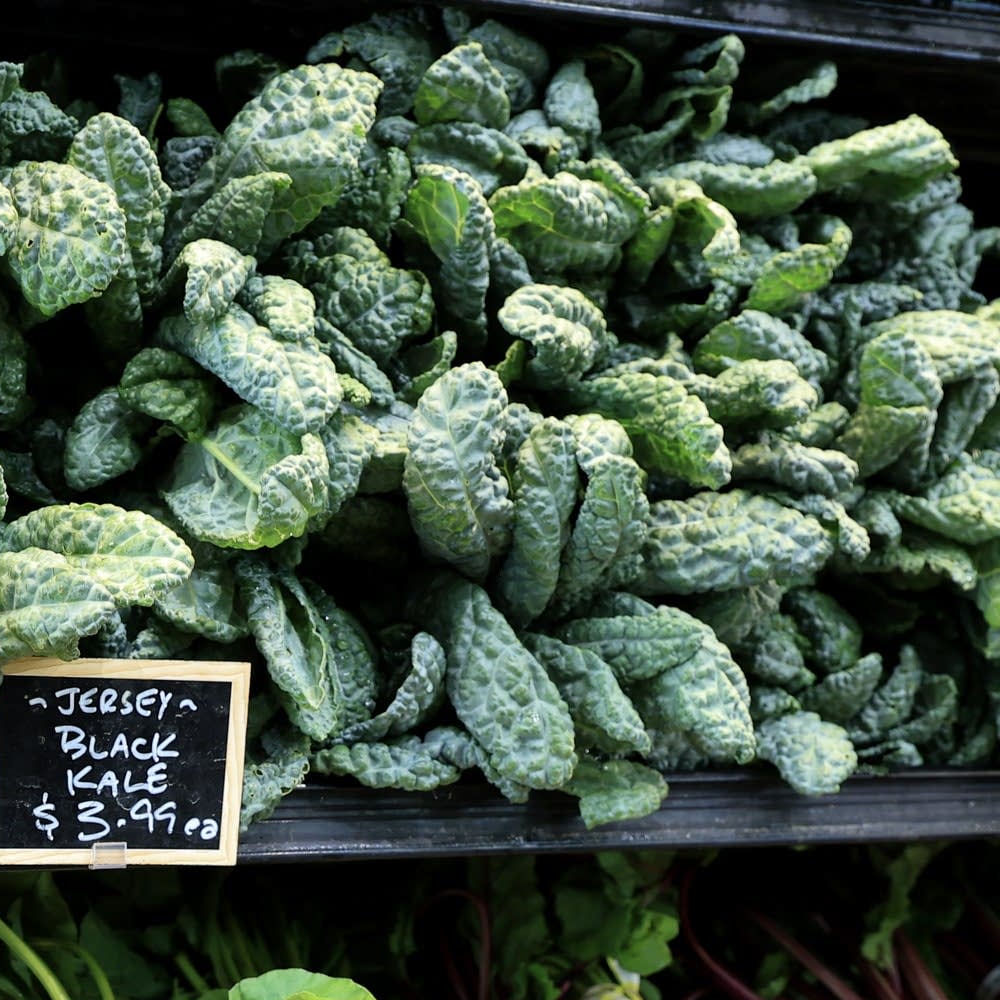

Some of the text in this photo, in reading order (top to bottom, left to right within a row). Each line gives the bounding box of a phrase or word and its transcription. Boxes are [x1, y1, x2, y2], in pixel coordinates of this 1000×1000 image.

[55, 687, 173, 720] JERSEY
[55, 725, 179, 763] BLACK
[67, 762, 168, 797] KALE
[184, 817, 219, 840] ea
